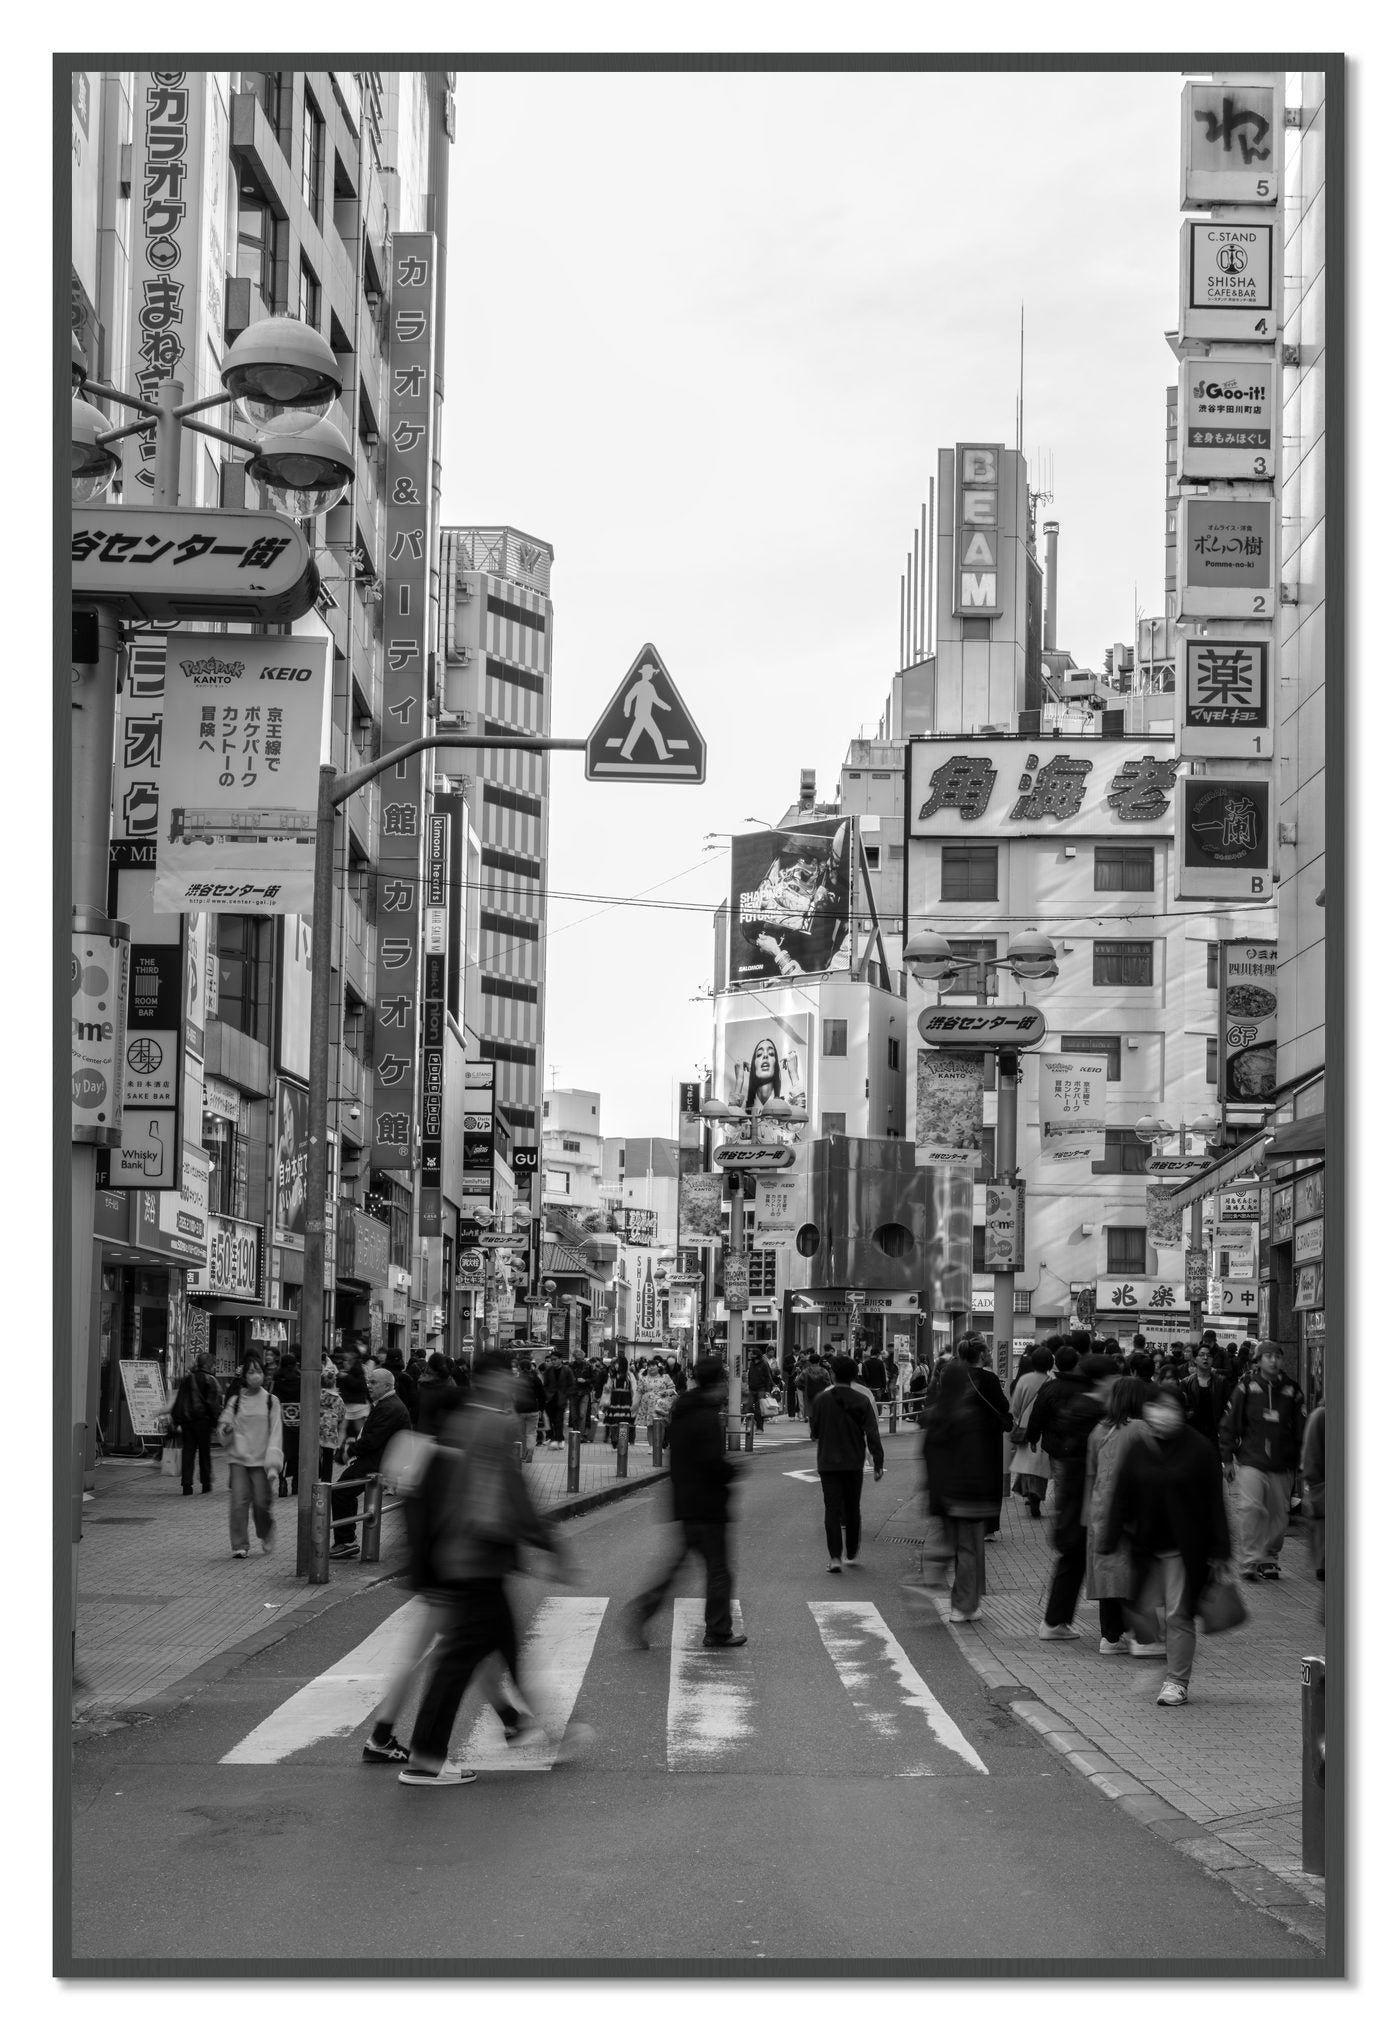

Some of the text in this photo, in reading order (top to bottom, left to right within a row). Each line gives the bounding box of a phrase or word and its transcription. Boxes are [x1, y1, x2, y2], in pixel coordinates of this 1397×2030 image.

[144, 86, 188, 236] カラオケ
[1256, 180, 1270, 197] 5
[1207, 231, 1257, 242] C.STAND
[1207, 276, 1257, 288] SHISHA
[1207, 288, 1257, 297] CAFE&BAR
[1254, 318, 1268, 335] 4
[1206, 382, 1266, 400] Goo-it!
[1198, 404, 1261, 414] 渋谷宇田川町店
[1193, 432, 1266, 445] 全身もみほぐし
[1253, 456, 1267, 474] 3
[961, 449, 998, 607] BEAM
[1193, 534, 1264, 555] ポムの樹
[1205, 560, 1255, 568] Pomme-no-ki
[1252, 595, 1266, 613] 2
[193, 676, 232, 684] KANTO
[259, 667, 313, 682] KEIO
[1198, 649, 1252, 704] 薬
[1191, 708, 1259, 723] マツモトキヨシ
[199, 706, 216, 752] 冒険へ
[218, 706, 238, 787] カントーの
[241, 706, 261, 788] ポケパーク
[264, 707, 283, 772] 京王線で
[1252, 735, 1261, 753] 1
[919, 755, 1178, 820] 角海老
[432, 819, 443, 901] kimono hearts
[185, 884, 282, 898] 渋谷センター街
[1251, 876, 1264, 894] B
[135, 966, 159, 974] THIRD
[1229, 963, 1276, 976] 四川料理
[926, 1016, 1038, 1030] 渋谷センター街
[1226, 1026, 1258, 1047] 6F
[122, 1150, 158, 1162] Whisky
[515, 1154, 537, 1165] GU
[717, 1150, 785, 1160] 渋谷センター街
[121, 1160, 143, 1169] Bank
[1111, 1284, 1176, 1307] 兆楽
